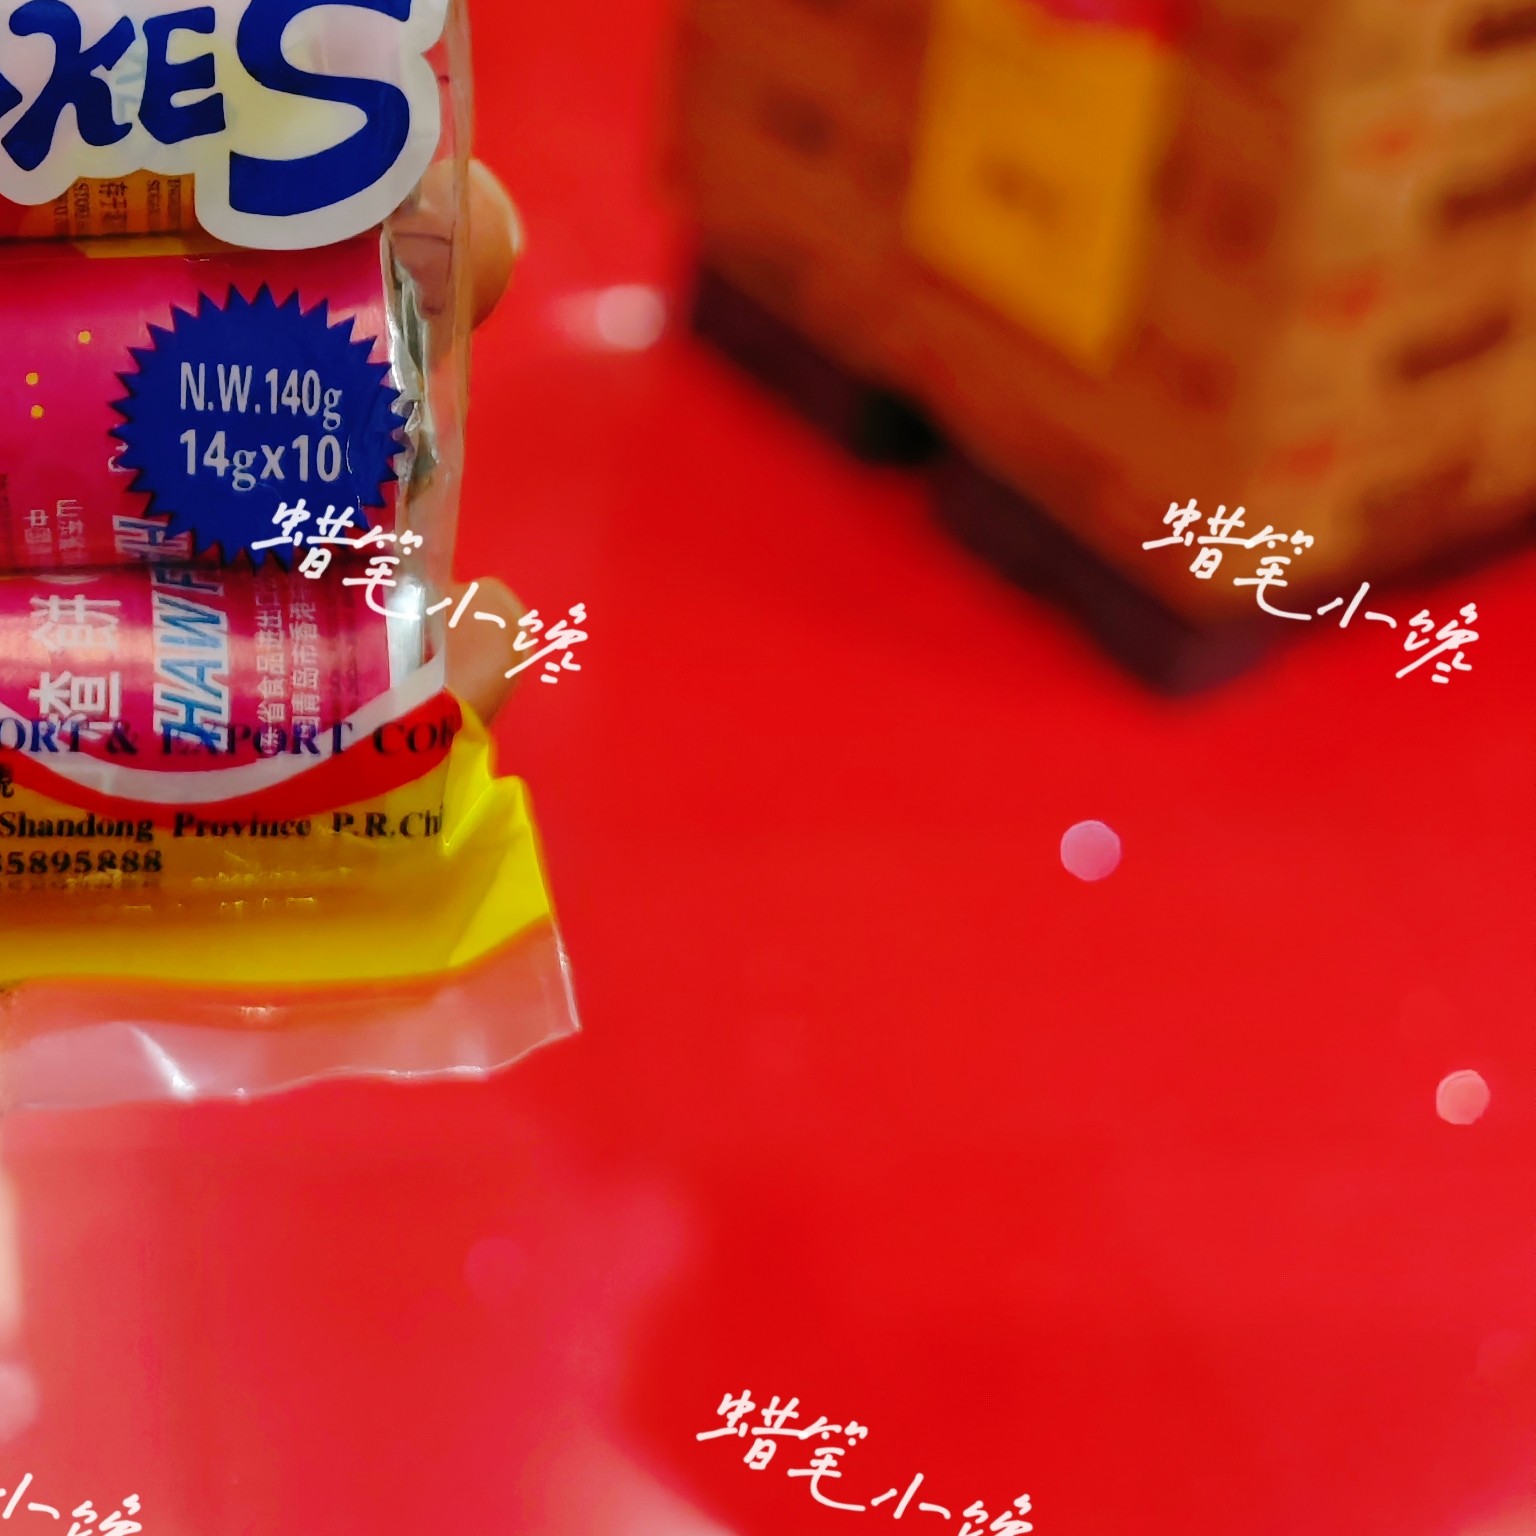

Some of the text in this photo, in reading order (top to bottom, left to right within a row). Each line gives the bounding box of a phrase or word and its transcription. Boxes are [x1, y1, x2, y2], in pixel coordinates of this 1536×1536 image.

[180, 361, 342, 431] N.W.140g
[179, 429, 342, 492] 14gx10
[106, 718, 138, 755] &
[172, 810, 312, 839] Province
